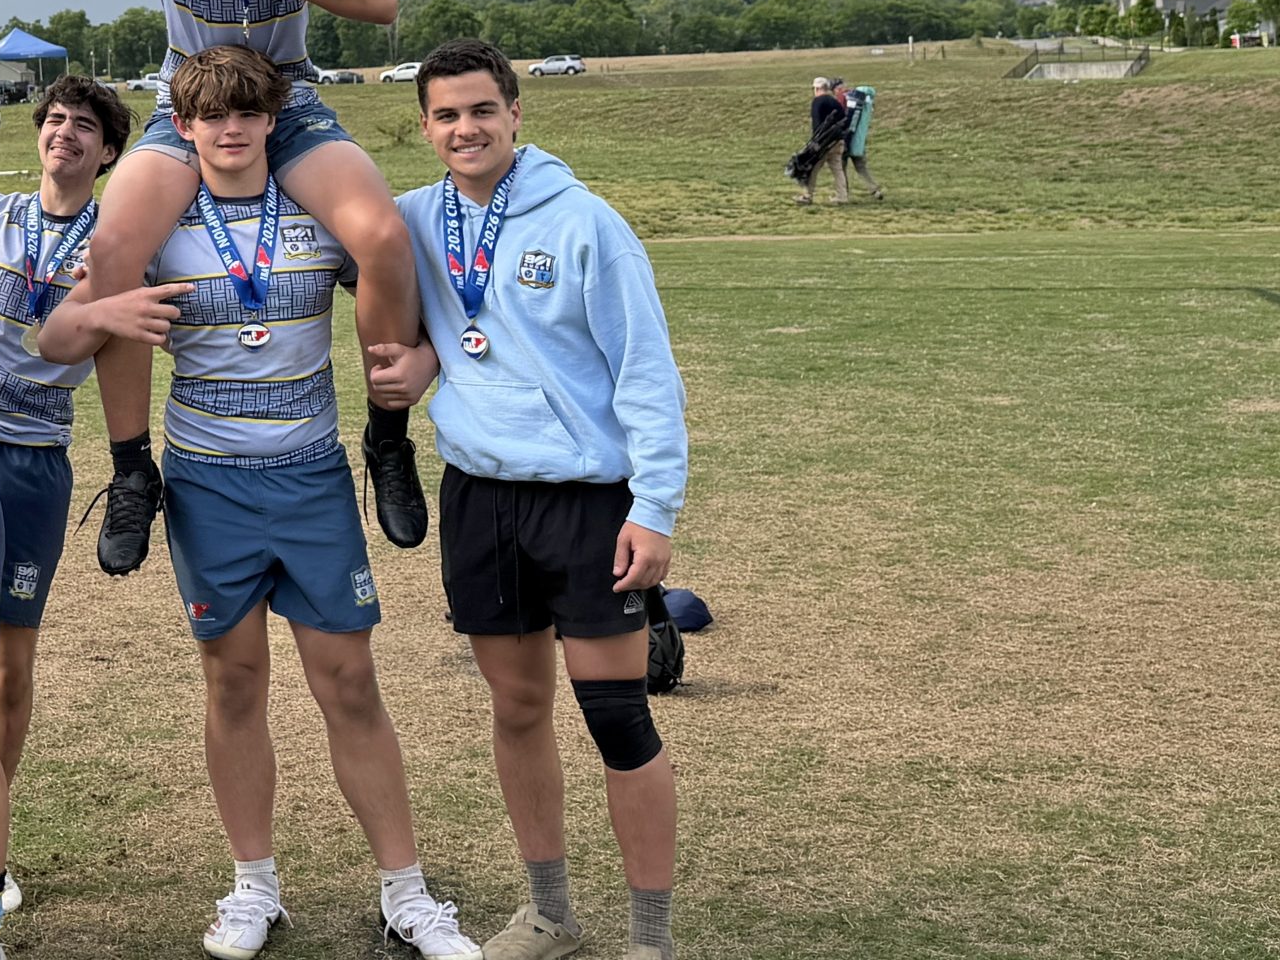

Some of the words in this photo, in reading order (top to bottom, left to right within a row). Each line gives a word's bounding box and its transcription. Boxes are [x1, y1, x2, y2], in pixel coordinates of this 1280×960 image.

[445, 176, 457, 217] CHAM
[54, 212, 90, 260] CHAMPION
[198, 191, 231, 249] CHAMPION
[261, 216, 276, 248] 2026
[447, 219, 460, 253] 2026
[482, 214, 500, 250] 2026
[28, 232, 38, 259] 2026
